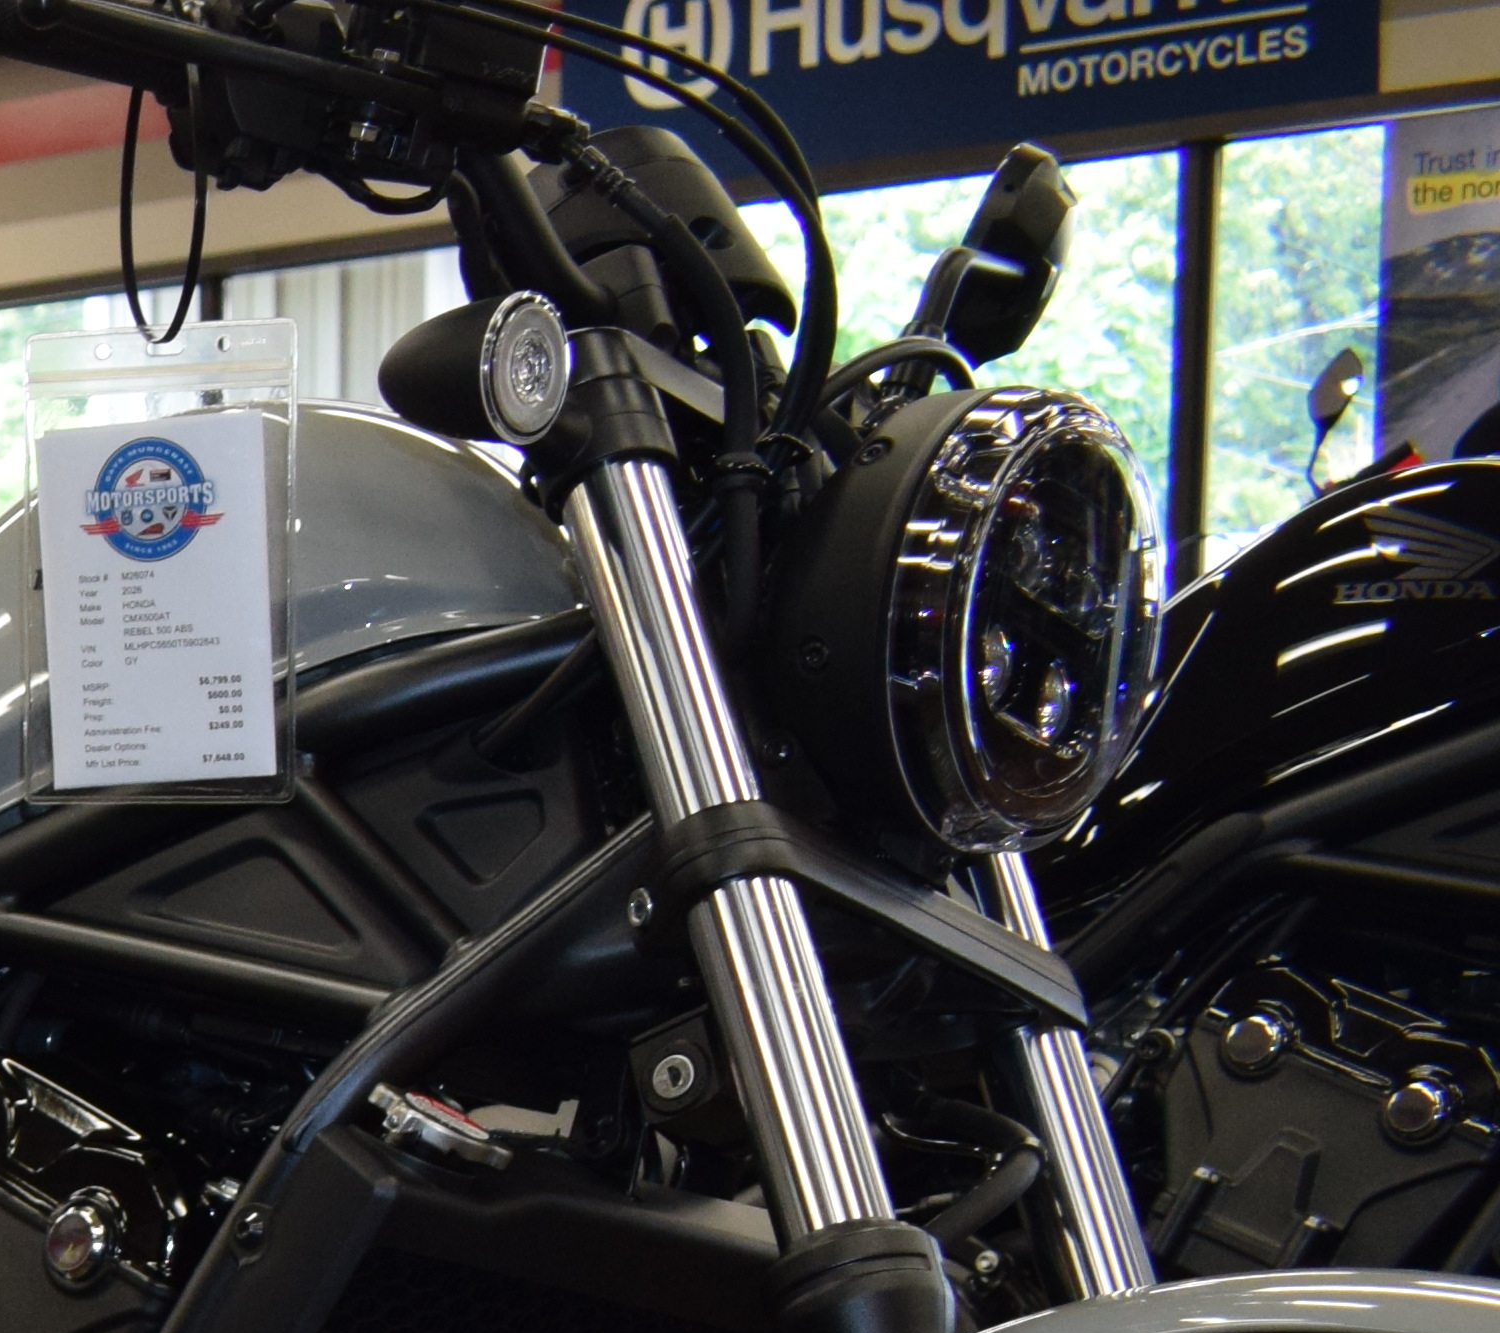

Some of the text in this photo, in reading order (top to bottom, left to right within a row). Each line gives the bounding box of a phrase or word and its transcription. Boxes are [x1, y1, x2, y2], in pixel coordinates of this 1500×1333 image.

[750, 0, 1282, 76] Husqv
[1018, 25, 1310, 97] MOTORCYCLES
[1413, 149, 1475, 173] Trust
[1413, 181, 1453, 206] the
[86, 482, 214, 514] MOTORSPORTS
[1334, 579, 1497, 603] HONDA
[122, 600, 156, 609] HONDA
[80, 617, 104, 625] Model
[123, 628, 153, 636] REBEL
[174, 624, 193, 632] ABS
[219, 705, 243, 713] $0.00
